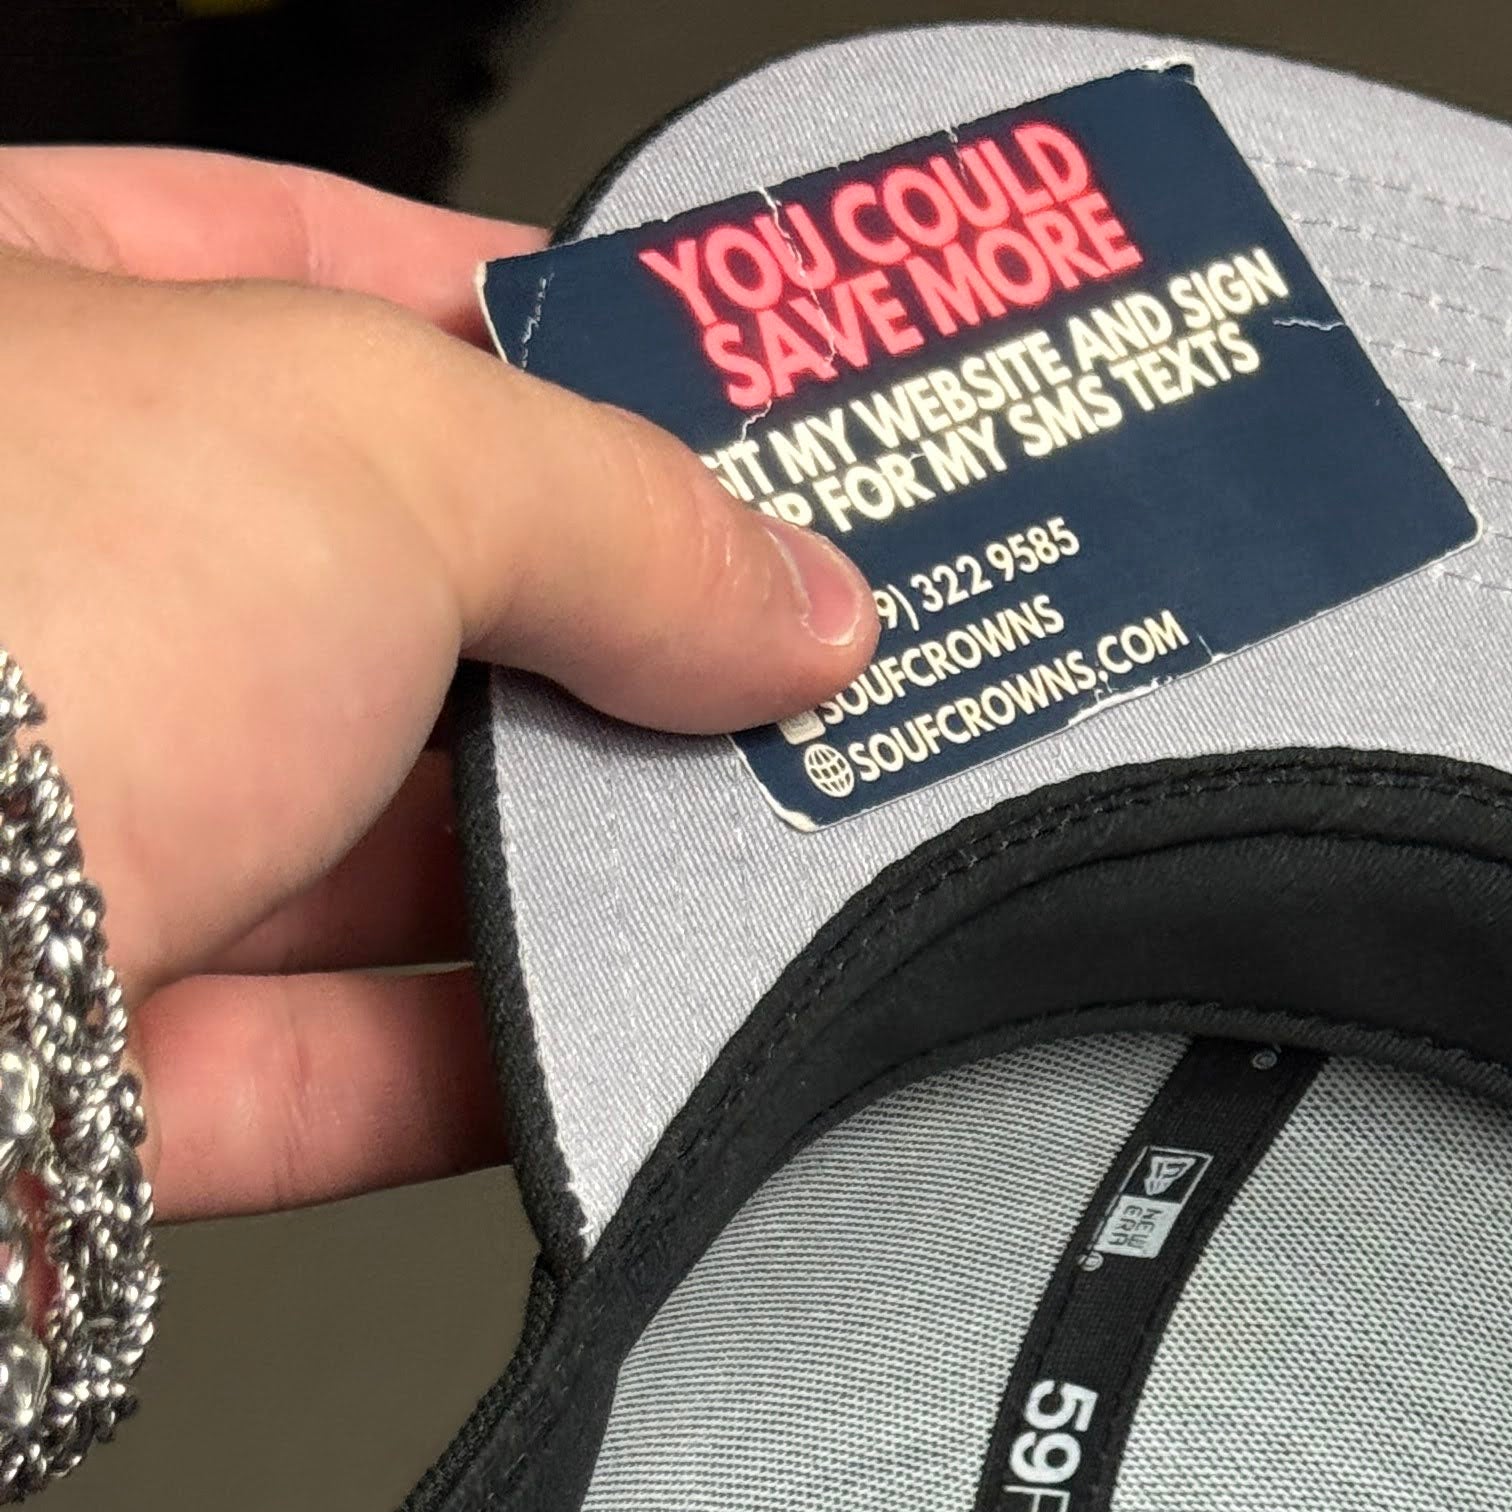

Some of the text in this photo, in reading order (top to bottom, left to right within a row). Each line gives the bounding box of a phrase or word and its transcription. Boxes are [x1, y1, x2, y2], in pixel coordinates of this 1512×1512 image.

[639, 121, 1090, 325] YOU COULD
[703, 192, 1143, 407] SAVE MORE
[767, 408, 857, 484] MY
[851, 330, 1072, 449] WEBSITE
[1067, 292, 1173, 371] AND
[1168, 247, 1289, 329] SIGN
[812, 454, 936, 533] FOR
[921, 416, 1008, 493] MY
[1008, 375, 1123, 457] SMS
[1107, 321, 1260, 411] TEXTS
[910, 555, 993, 612] 322
[986, 516, 1080, 582] 9585
[820, 594, 1065, 725] SOUFCROWNS
[848, 610, 1190, 783] SOUFCROWNS.COM
[1107, 1205, 1142, 1245] ERA
[1126, 1208, 1164, 1249] NEW
